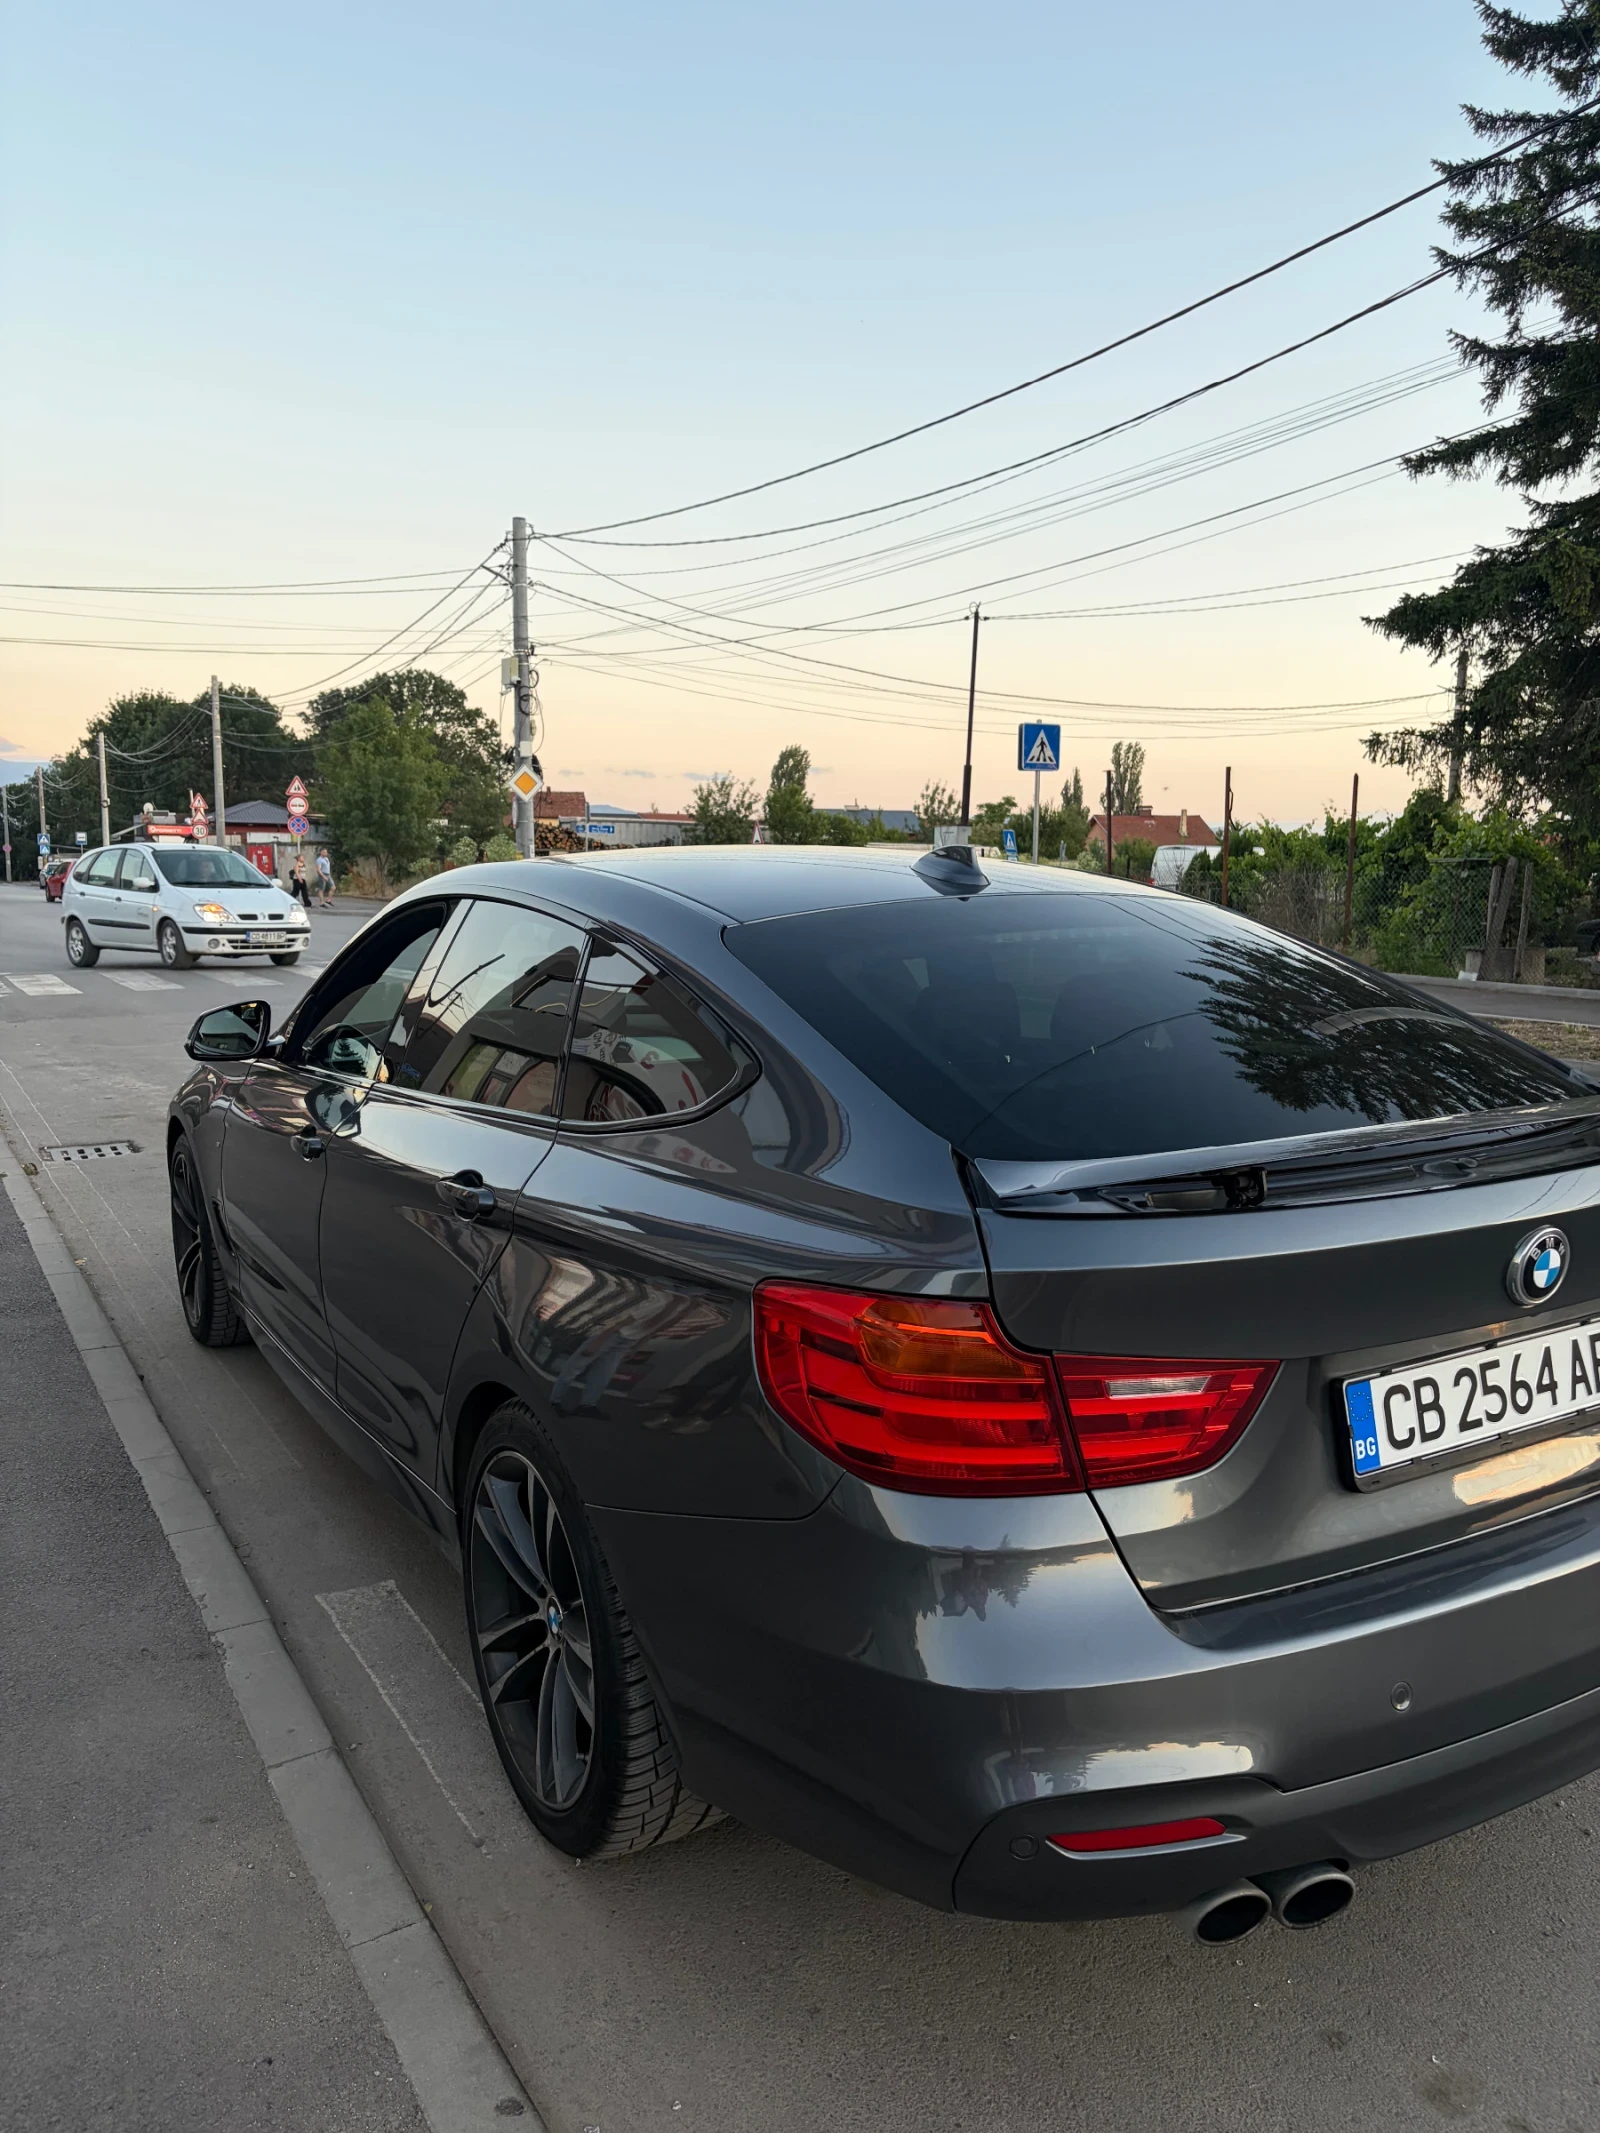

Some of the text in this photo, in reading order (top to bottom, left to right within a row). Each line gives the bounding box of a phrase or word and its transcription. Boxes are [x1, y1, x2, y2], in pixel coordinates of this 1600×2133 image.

[195, 827, 205, 835] 30
[1530, 1237, 1566, 1261] BMW
[1383, 1376, 1446, 1450] CB
[1453, 1345, 1558, 1433] 2564
[1355, 1437, 1376, 1460] BG
